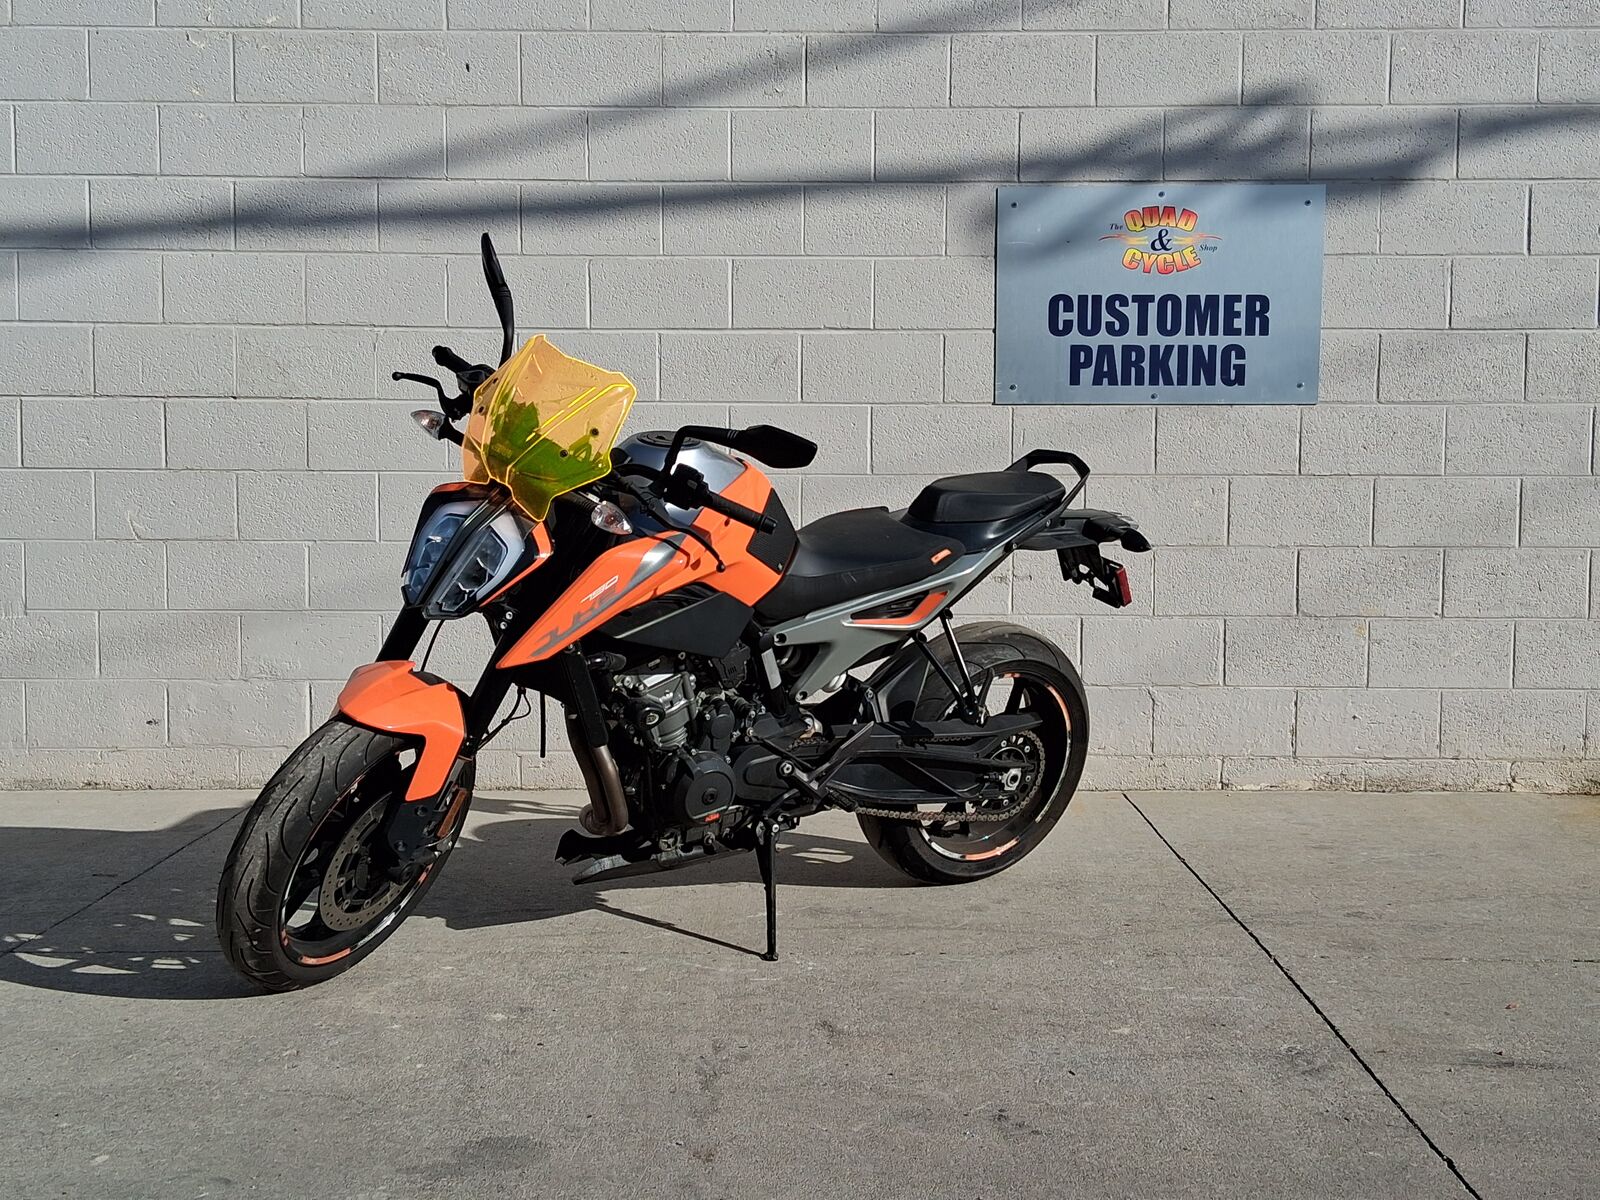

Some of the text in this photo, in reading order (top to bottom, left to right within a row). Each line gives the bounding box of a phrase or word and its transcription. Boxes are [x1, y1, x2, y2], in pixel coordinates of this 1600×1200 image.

[1124, 206, 1198, 232] QUAD
[1150, 229, 1172, 252] &
[1199, 244, 1218, 253] Shop
[1122, 246, 1201, 274] CYCLE
[1048, 294, 1270, 337] CUSTOMER
[1069, 344, 1246, 387] PARKING
